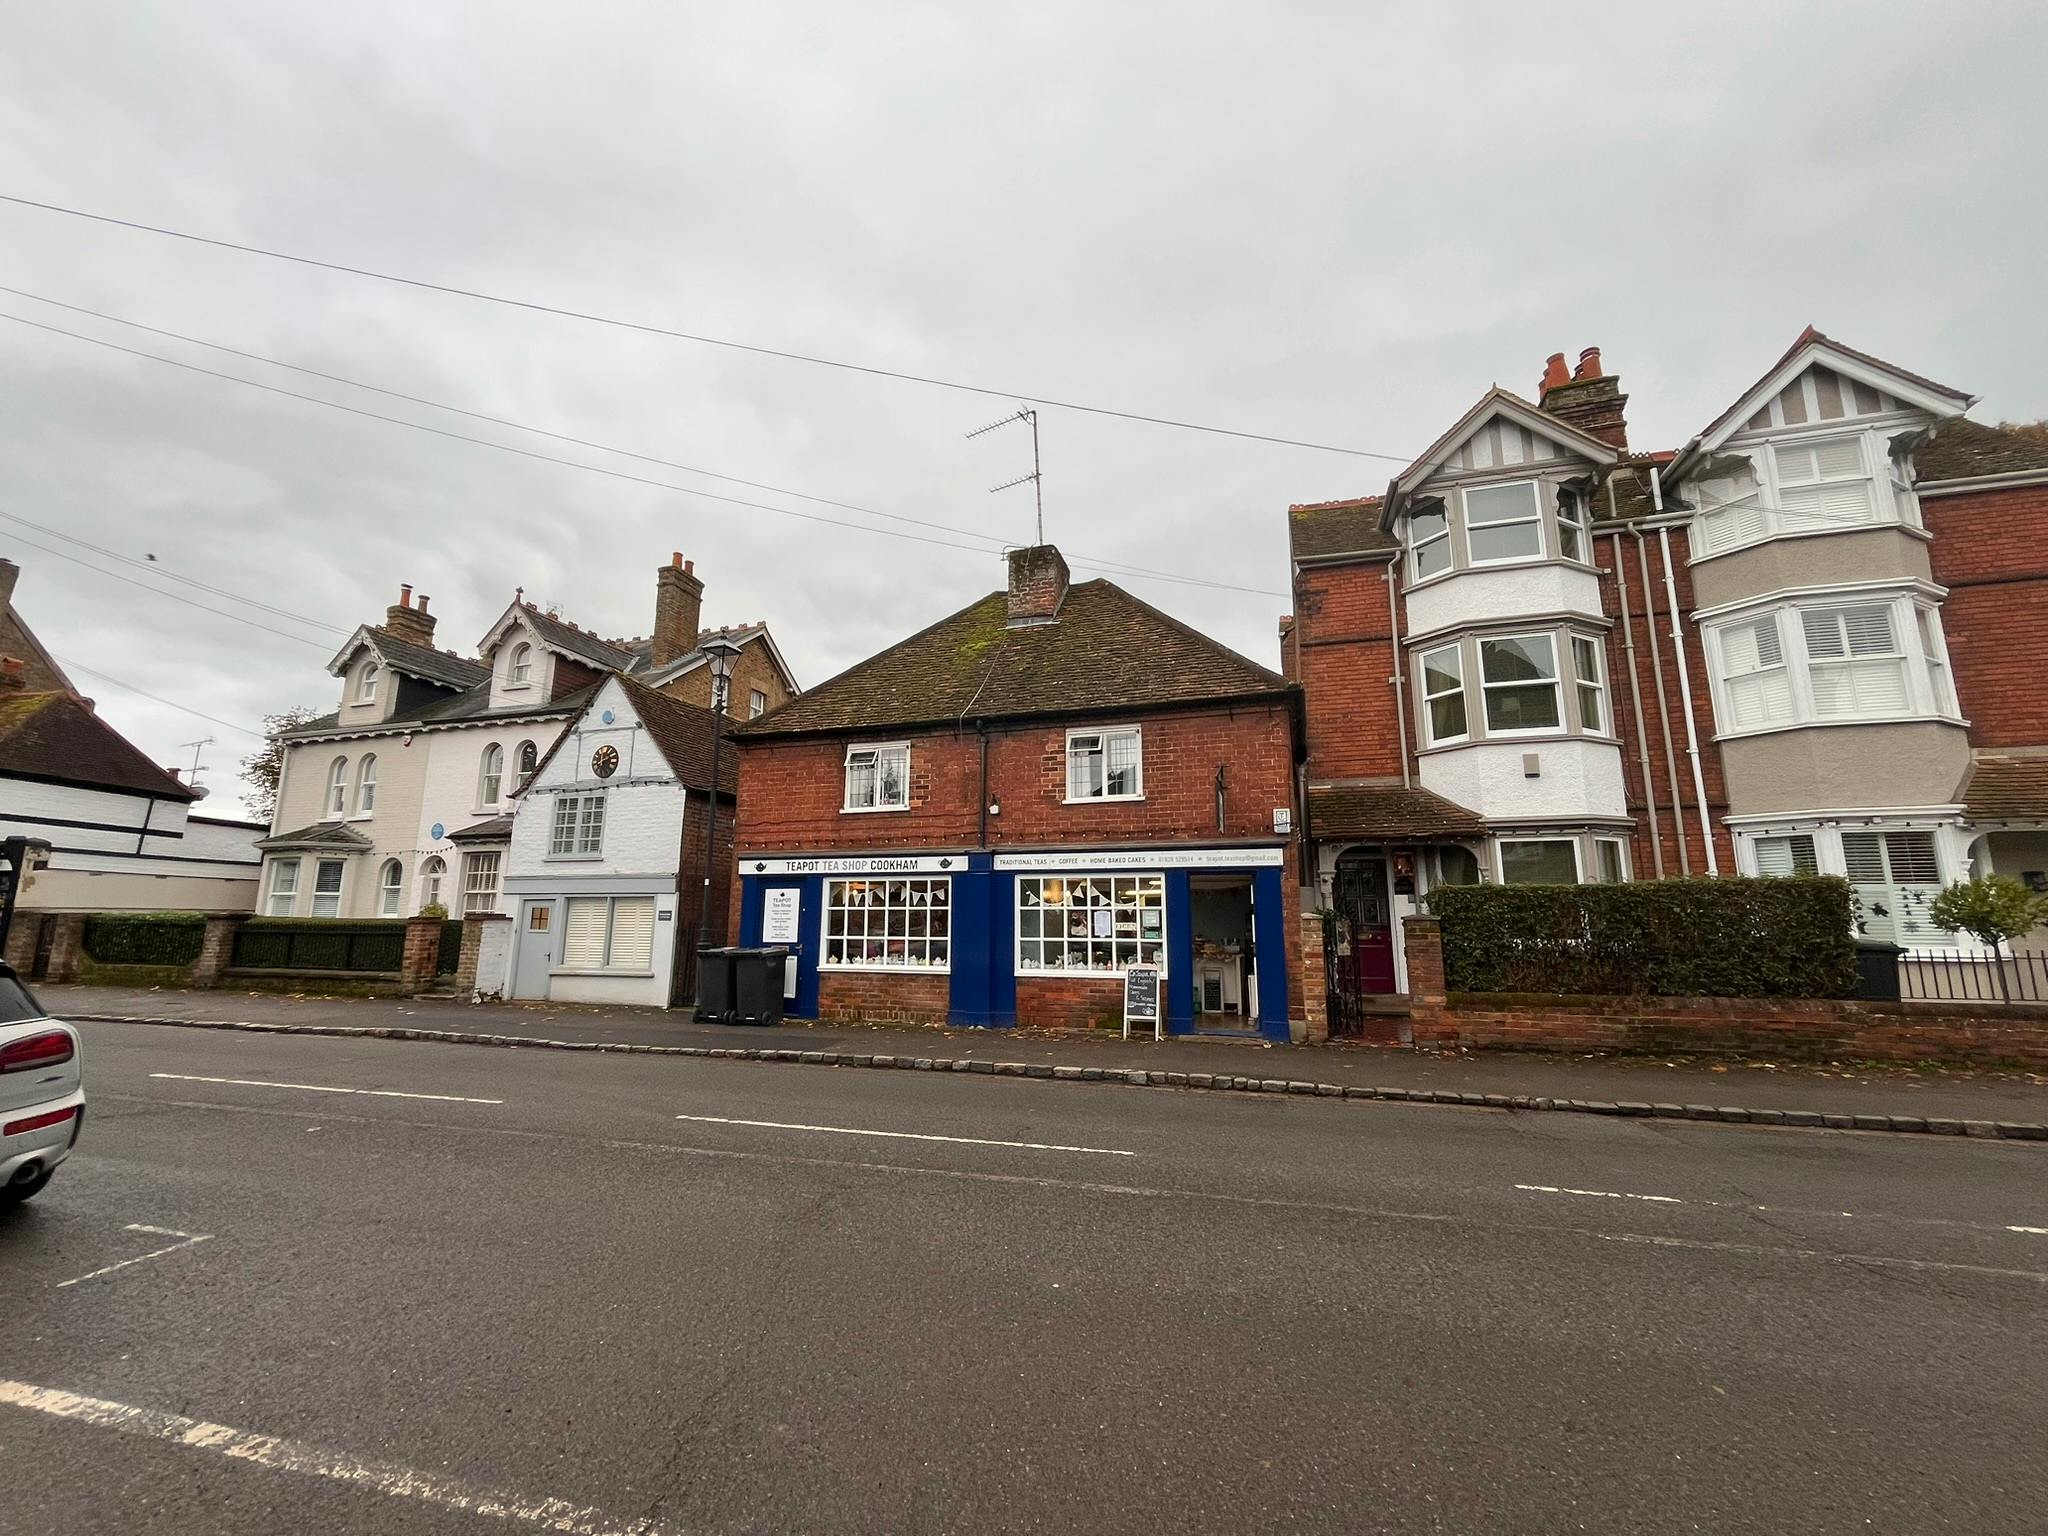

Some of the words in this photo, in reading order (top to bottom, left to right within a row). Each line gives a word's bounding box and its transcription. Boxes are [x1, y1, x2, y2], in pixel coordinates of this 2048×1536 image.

[786, 860, 820, 872] TEAPOT
[822, 860, 839, 871] TEA
[842, 860, 867, 871] SHOP
[870, 859, 918, 871] COOKHAM
